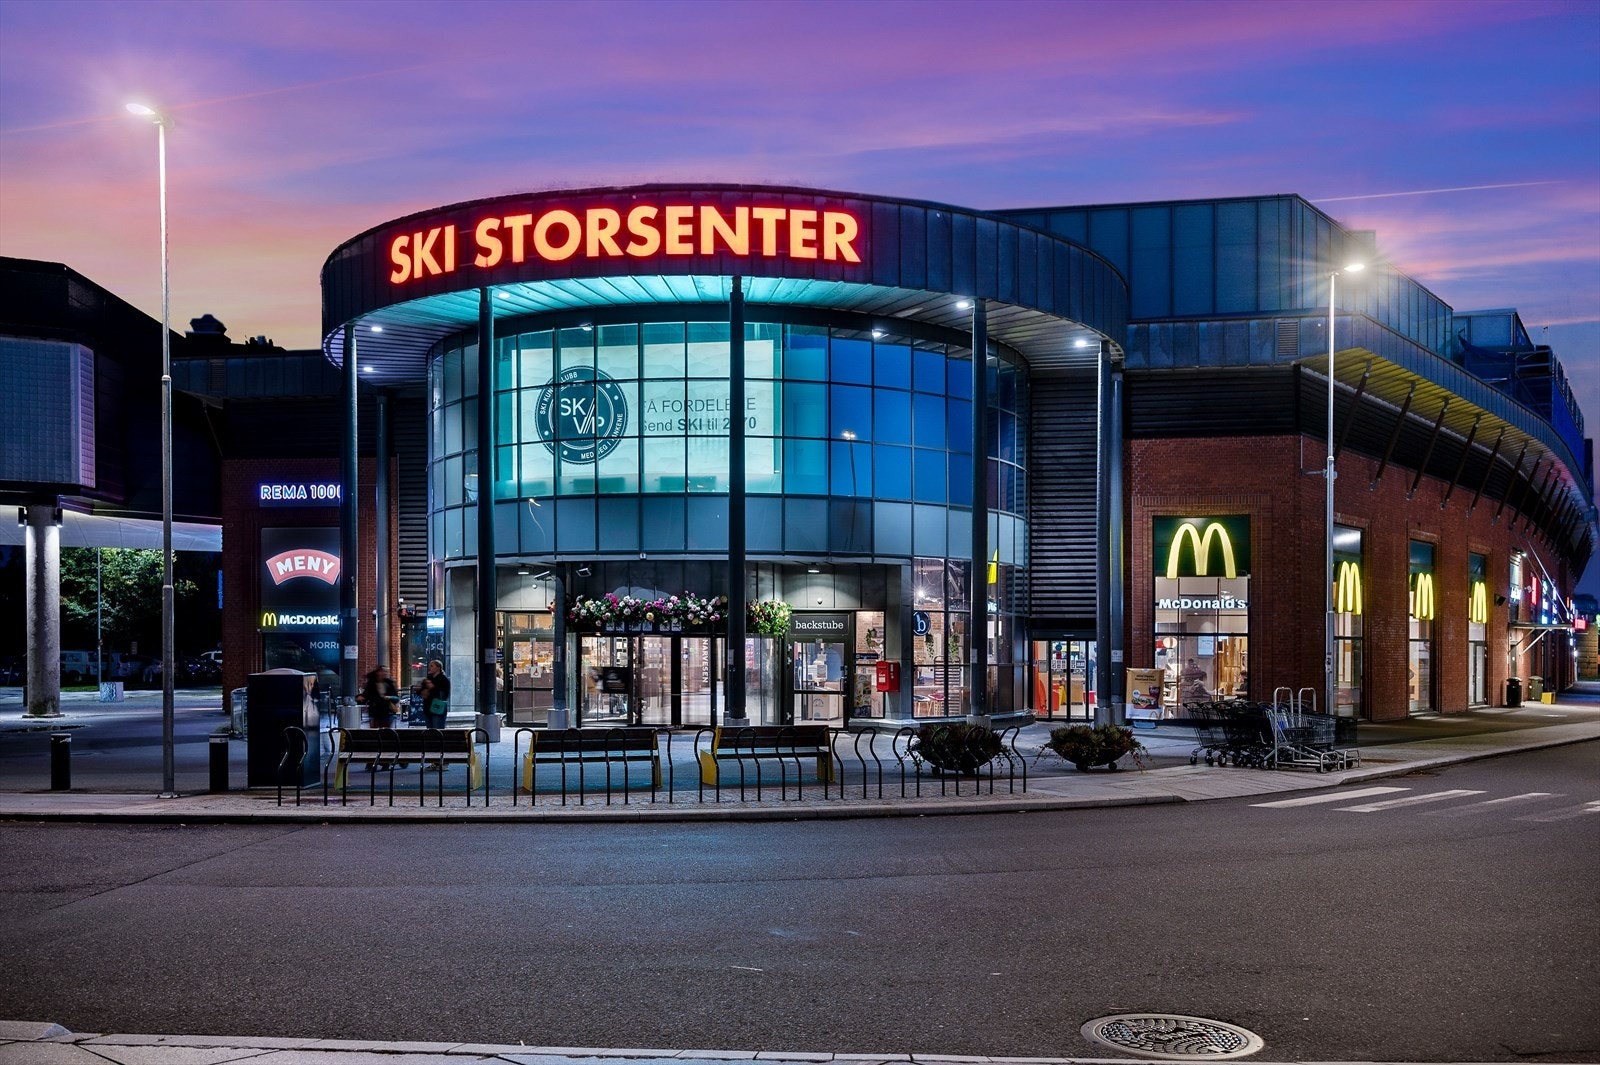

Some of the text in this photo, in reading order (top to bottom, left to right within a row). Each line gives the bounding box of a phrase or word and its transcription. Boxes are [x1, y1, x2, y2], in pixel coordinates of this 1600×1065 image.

[390, 205, 862, 284] SKI STORSENTER
[662, 397, 757, 413] FORDELEE
[677, 417, 702, 431] SKI
[707, 417, 718, 430] til
[261, 485, 308, 500] REMA
[275, 555, 335, 576] MENY
[1158, 598, 1247, 610] McDonald's
[278, 614, 340, 625] McDonald
[795, 620, 844, 630] backstube
[309, 641, 340, 649] MORR
